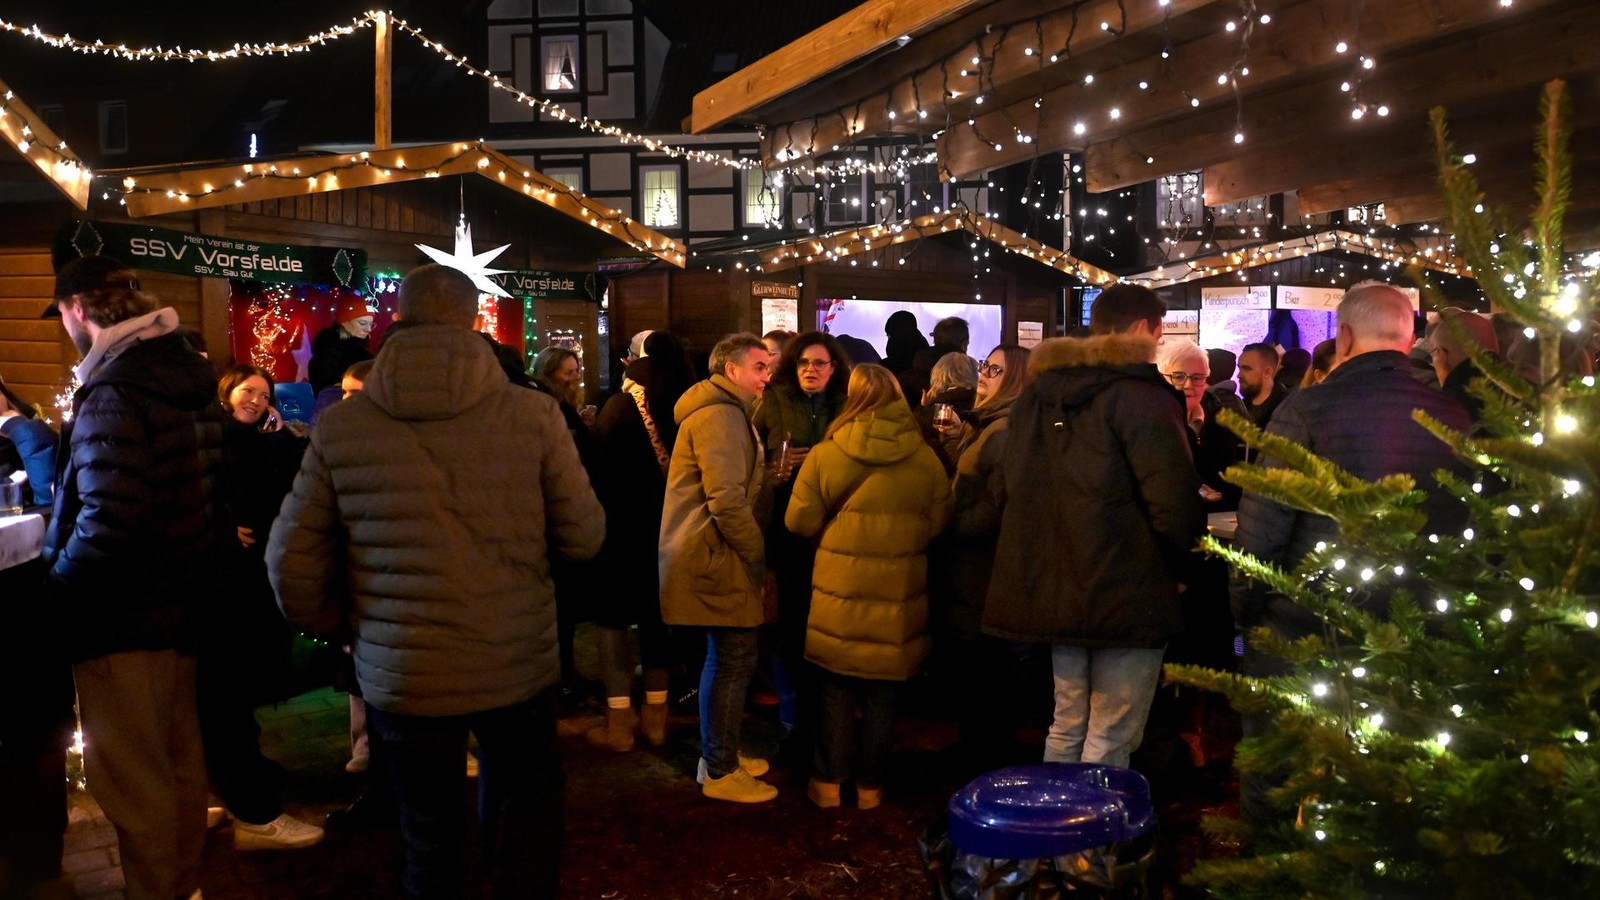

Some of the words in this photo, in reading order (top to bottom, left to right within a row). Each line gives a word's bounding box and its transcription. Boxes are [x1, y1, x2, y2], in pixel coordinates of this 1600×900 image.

[184, 235, 204, 245] Mein
[206, 238, 233, 249] Verein
[235, 242, 245, 250] ist
[247, 244, 260, 252] der
[130, 238, 188, 260] SSV
[198, 247, 303, 272] Vorsfelde
[222, 268, 239, 277] Sau
[240, 270, 254, 279] Gut
[513, 275, 575, 290] Vorsfelde
[1285, 291, 1300, 304] Bier
[1162, 315, 1179, 331] perol
